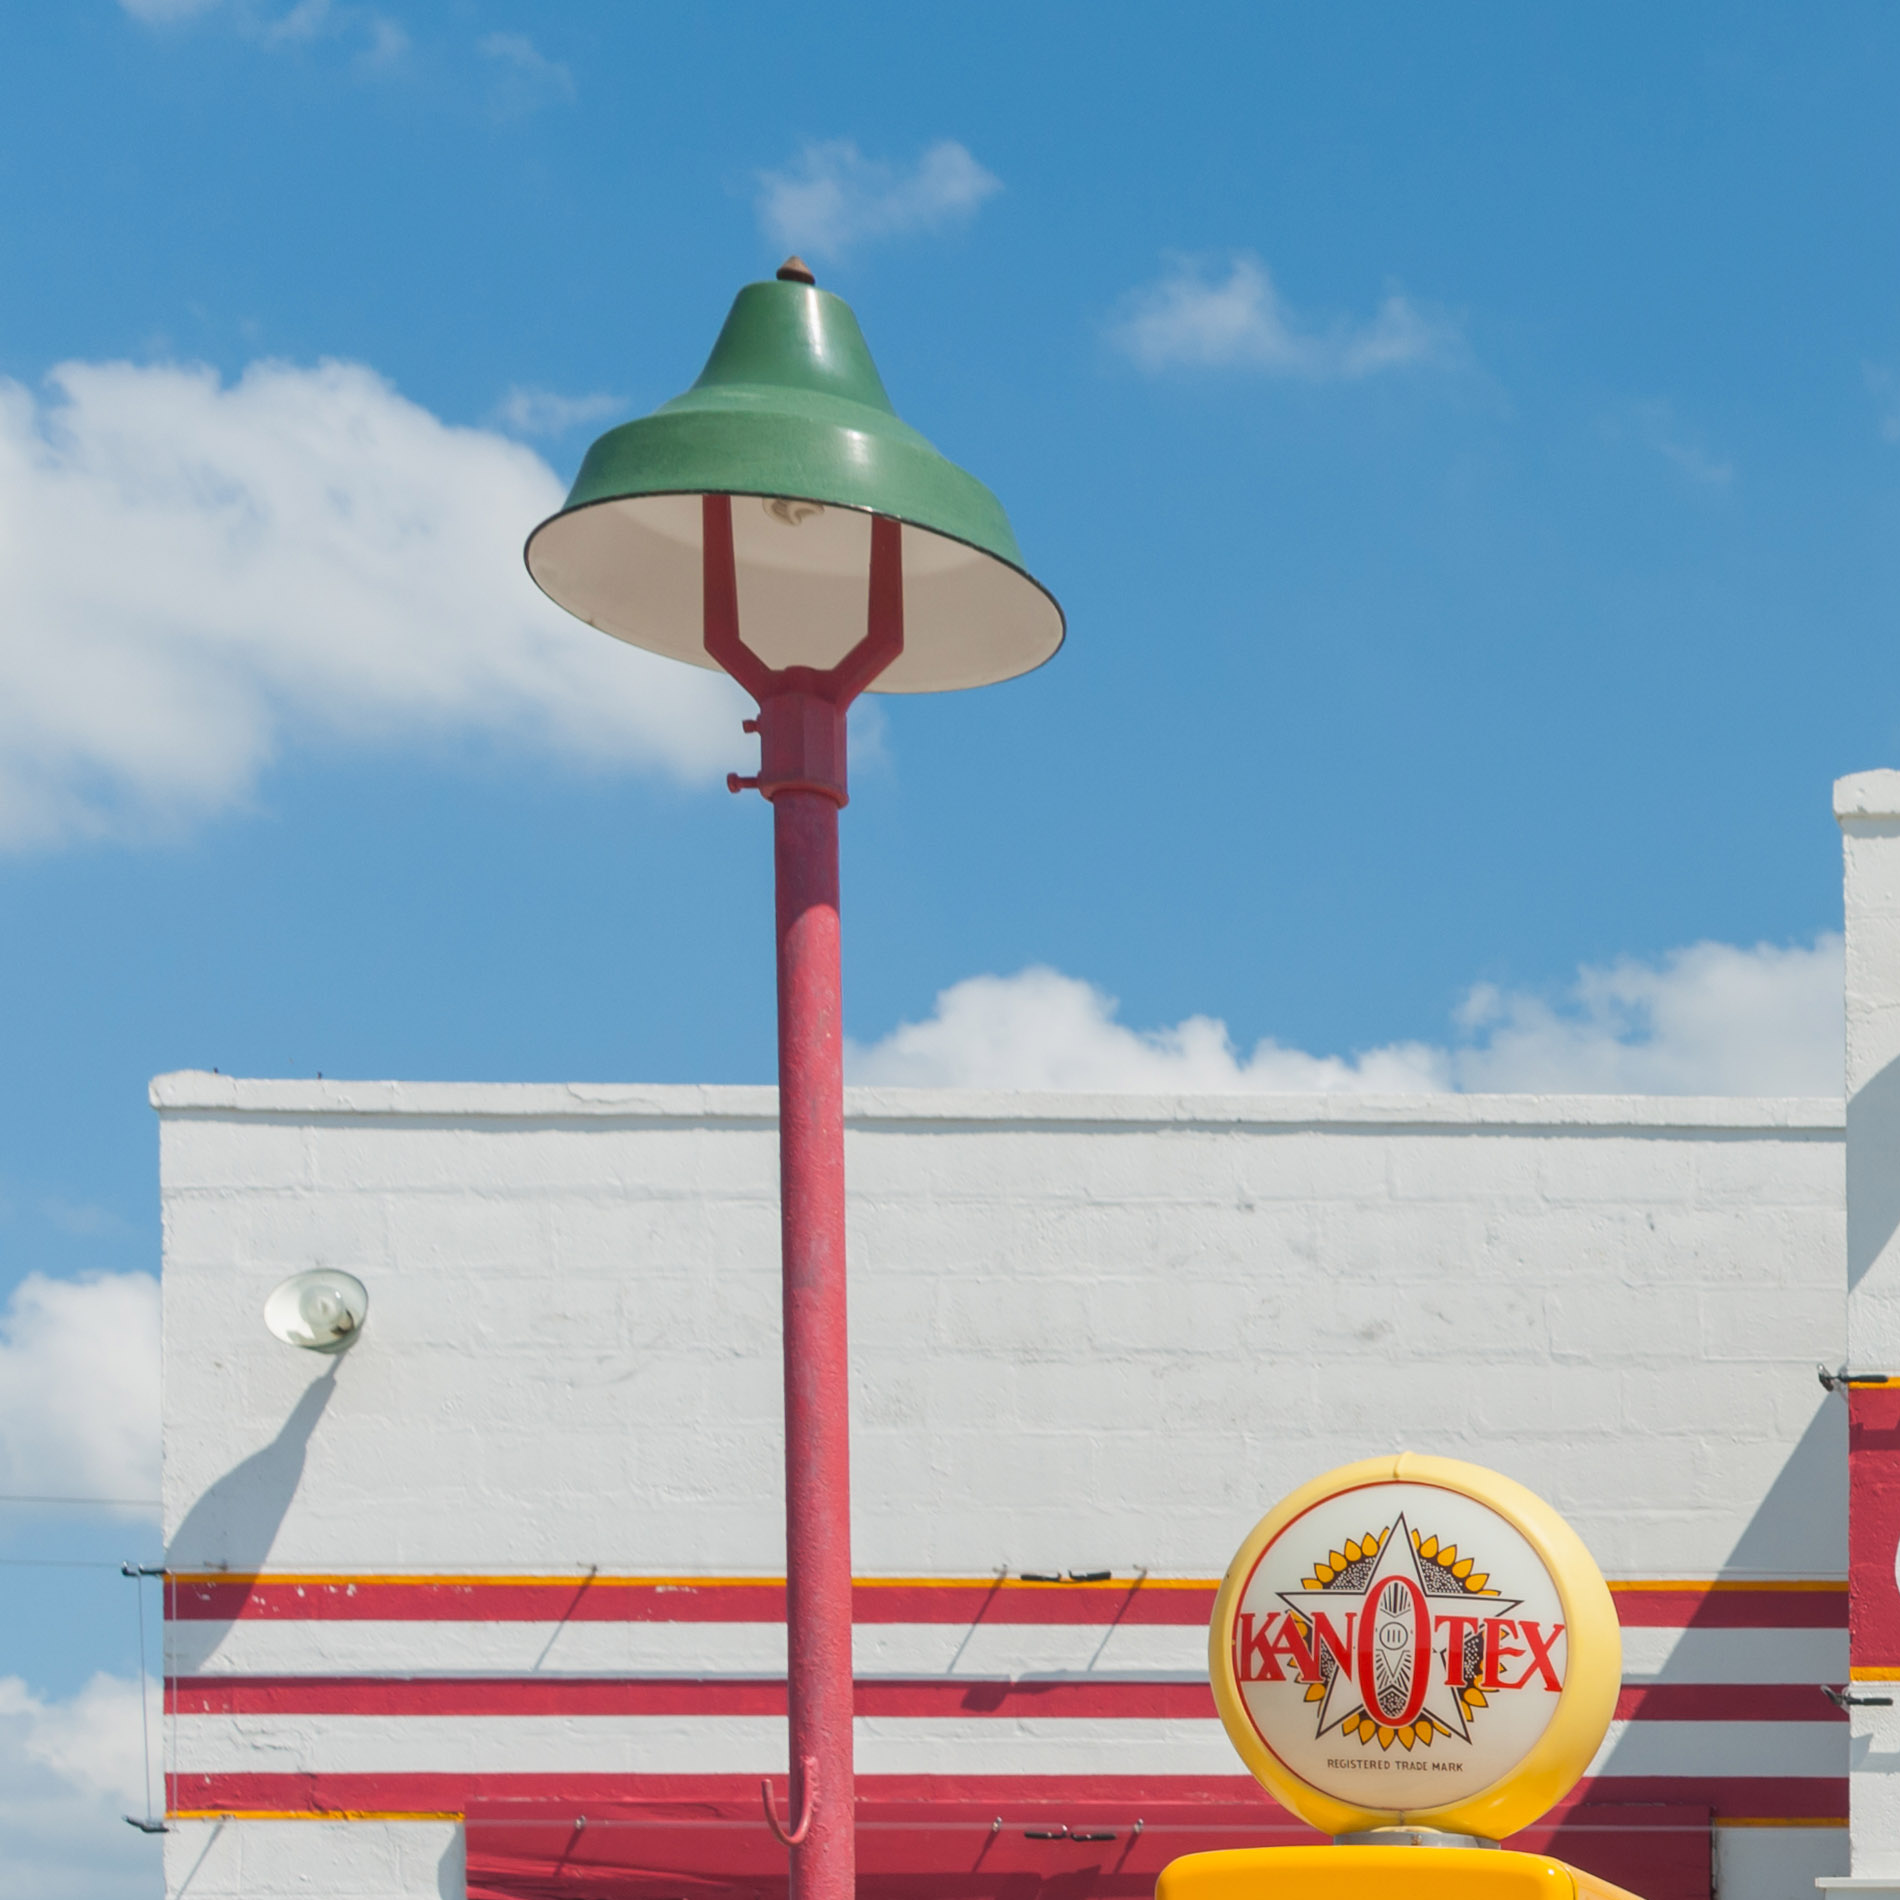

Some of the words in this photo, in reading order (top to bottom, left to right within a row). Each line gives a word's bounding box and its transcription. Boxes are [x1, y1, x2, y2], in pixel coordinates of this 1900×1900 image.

[1327, 1758, 1391, 1771] REGISTERED
[1395, 1760, 1429, 1772] TRADE
[1431, 1761, 1464, 1773] MARK
